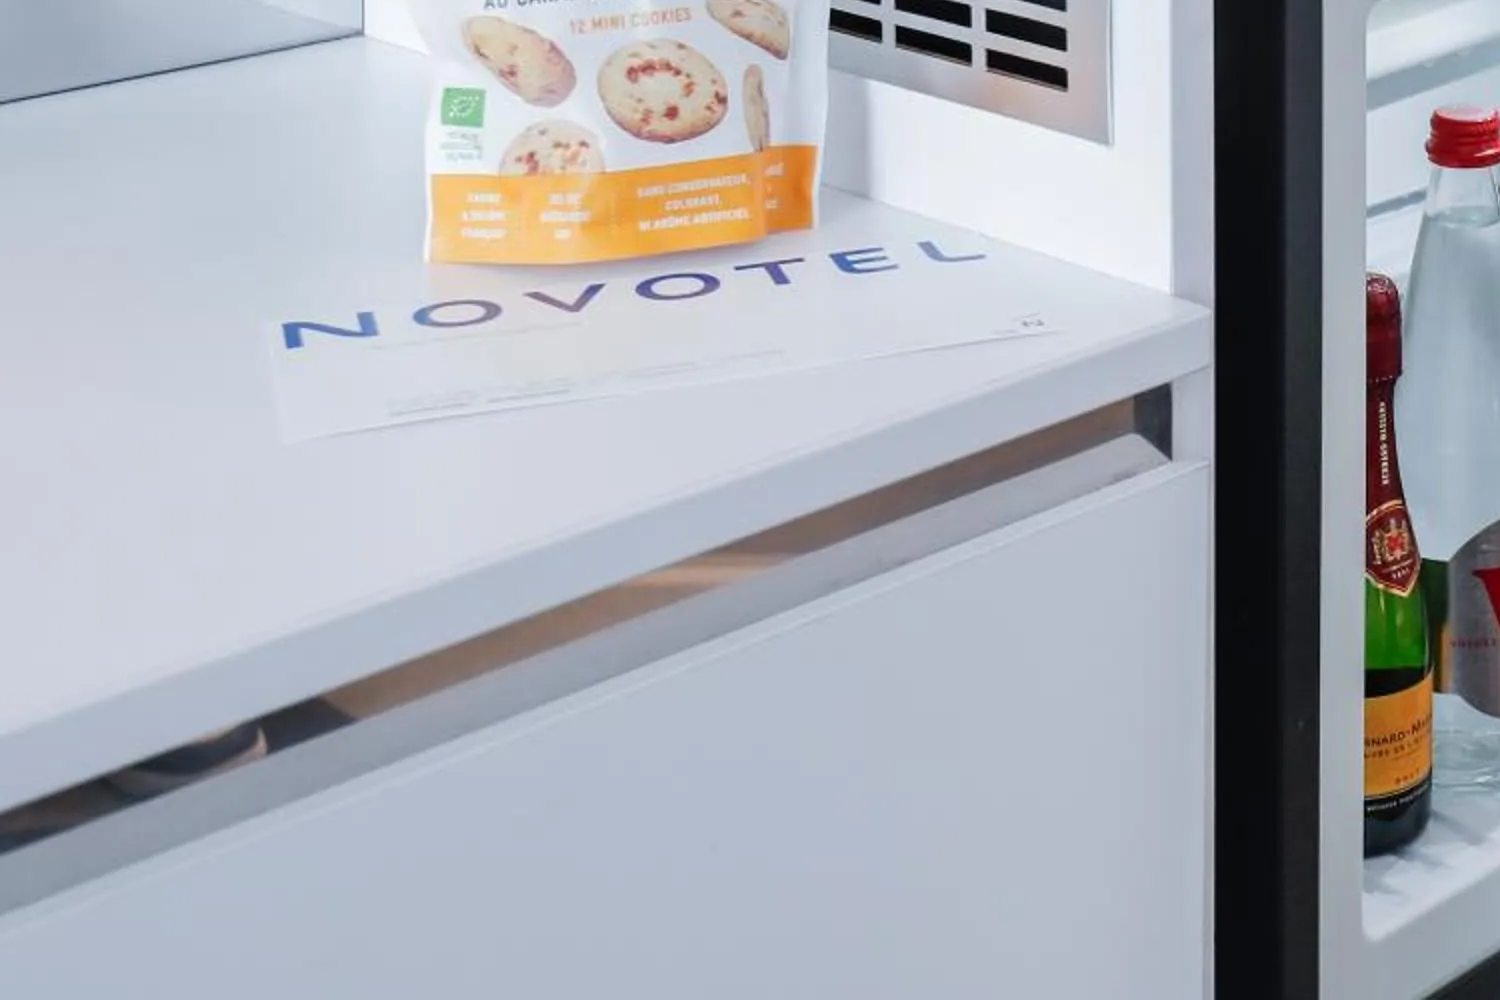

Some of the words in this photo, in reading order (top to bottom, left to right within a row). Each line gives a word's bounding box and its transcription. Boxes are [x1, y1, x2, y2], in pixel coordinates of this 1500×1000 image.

[591, 14, 626, 31] MINI
[631, 7, 692, 28] COOKIES
[281, 237, 988, 351] NOVOTEL
